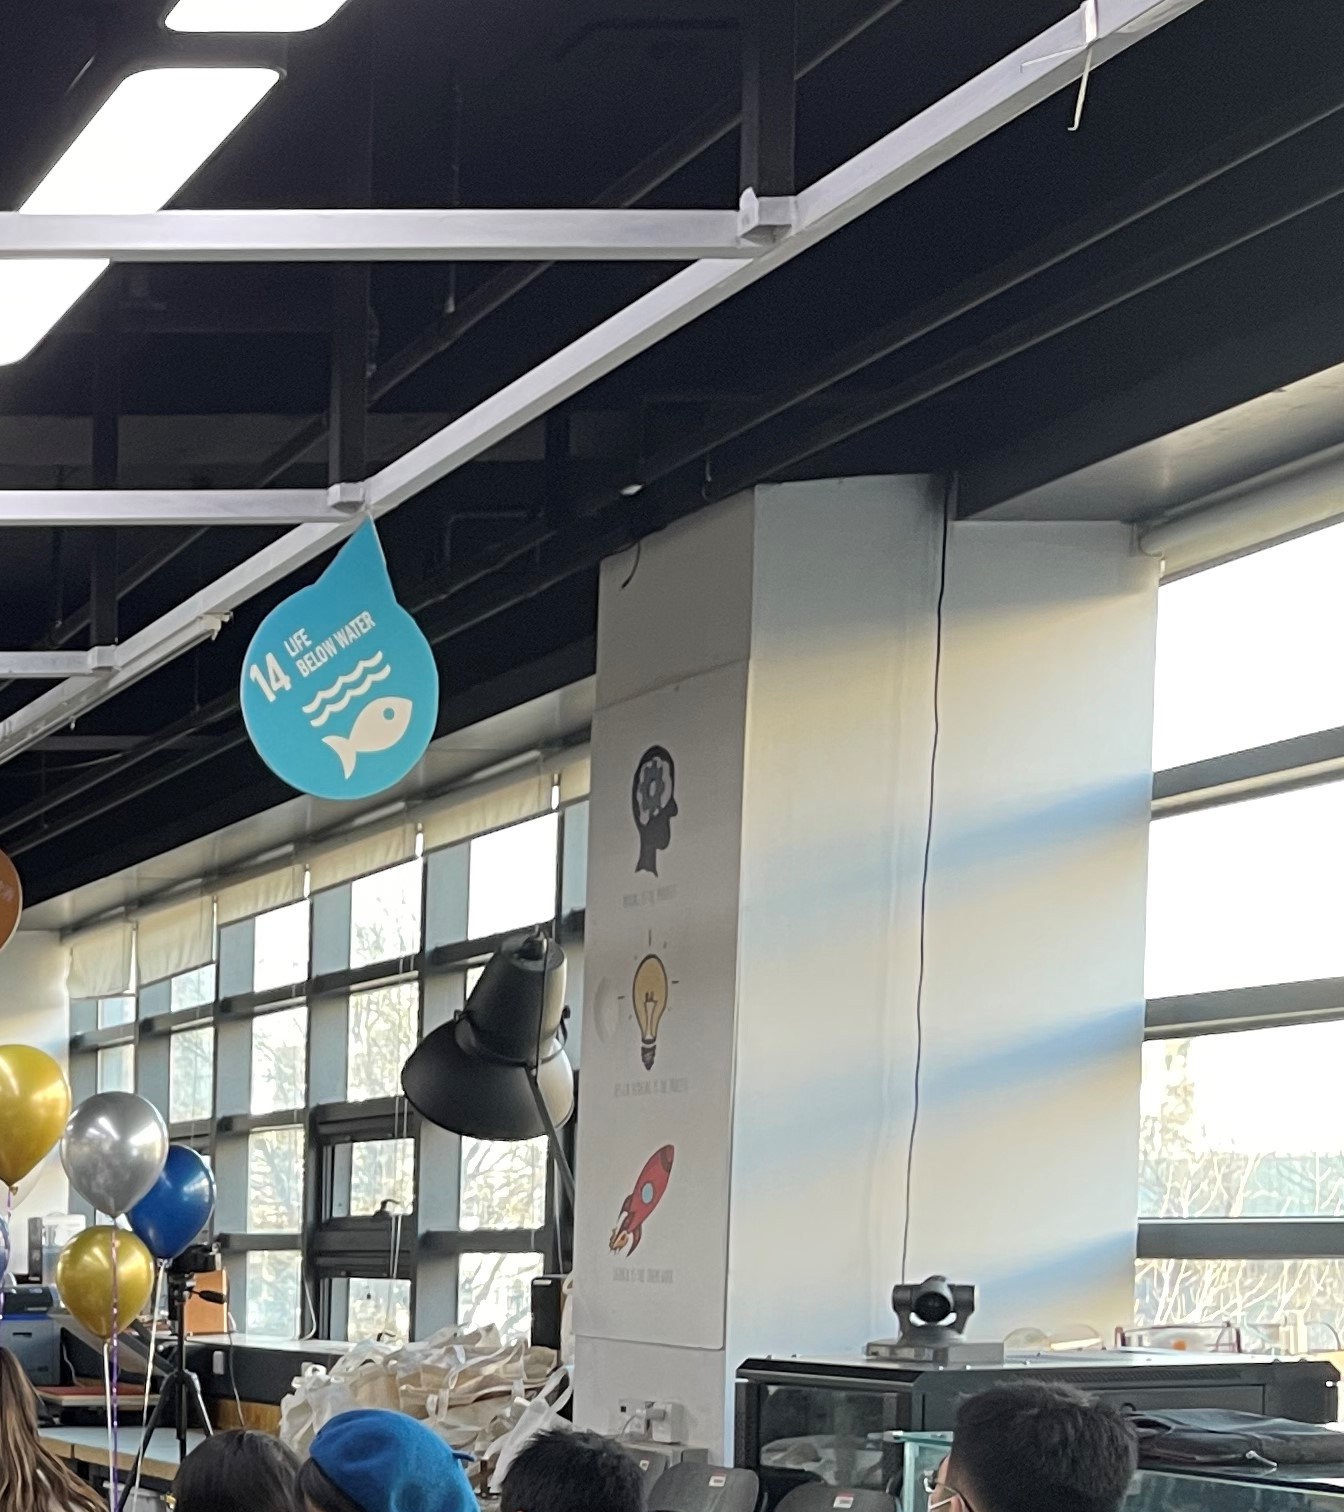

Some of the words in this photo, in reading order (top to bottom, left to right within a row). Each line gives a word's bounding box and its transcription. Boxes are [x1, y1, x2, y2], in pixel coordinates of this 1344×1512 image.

[284, 628, 312, 657] LIFE
[296, 637, 338, 678] BELOW
[332, 610, 376, 650] WATER
[249, 652, 292, 703] 14
